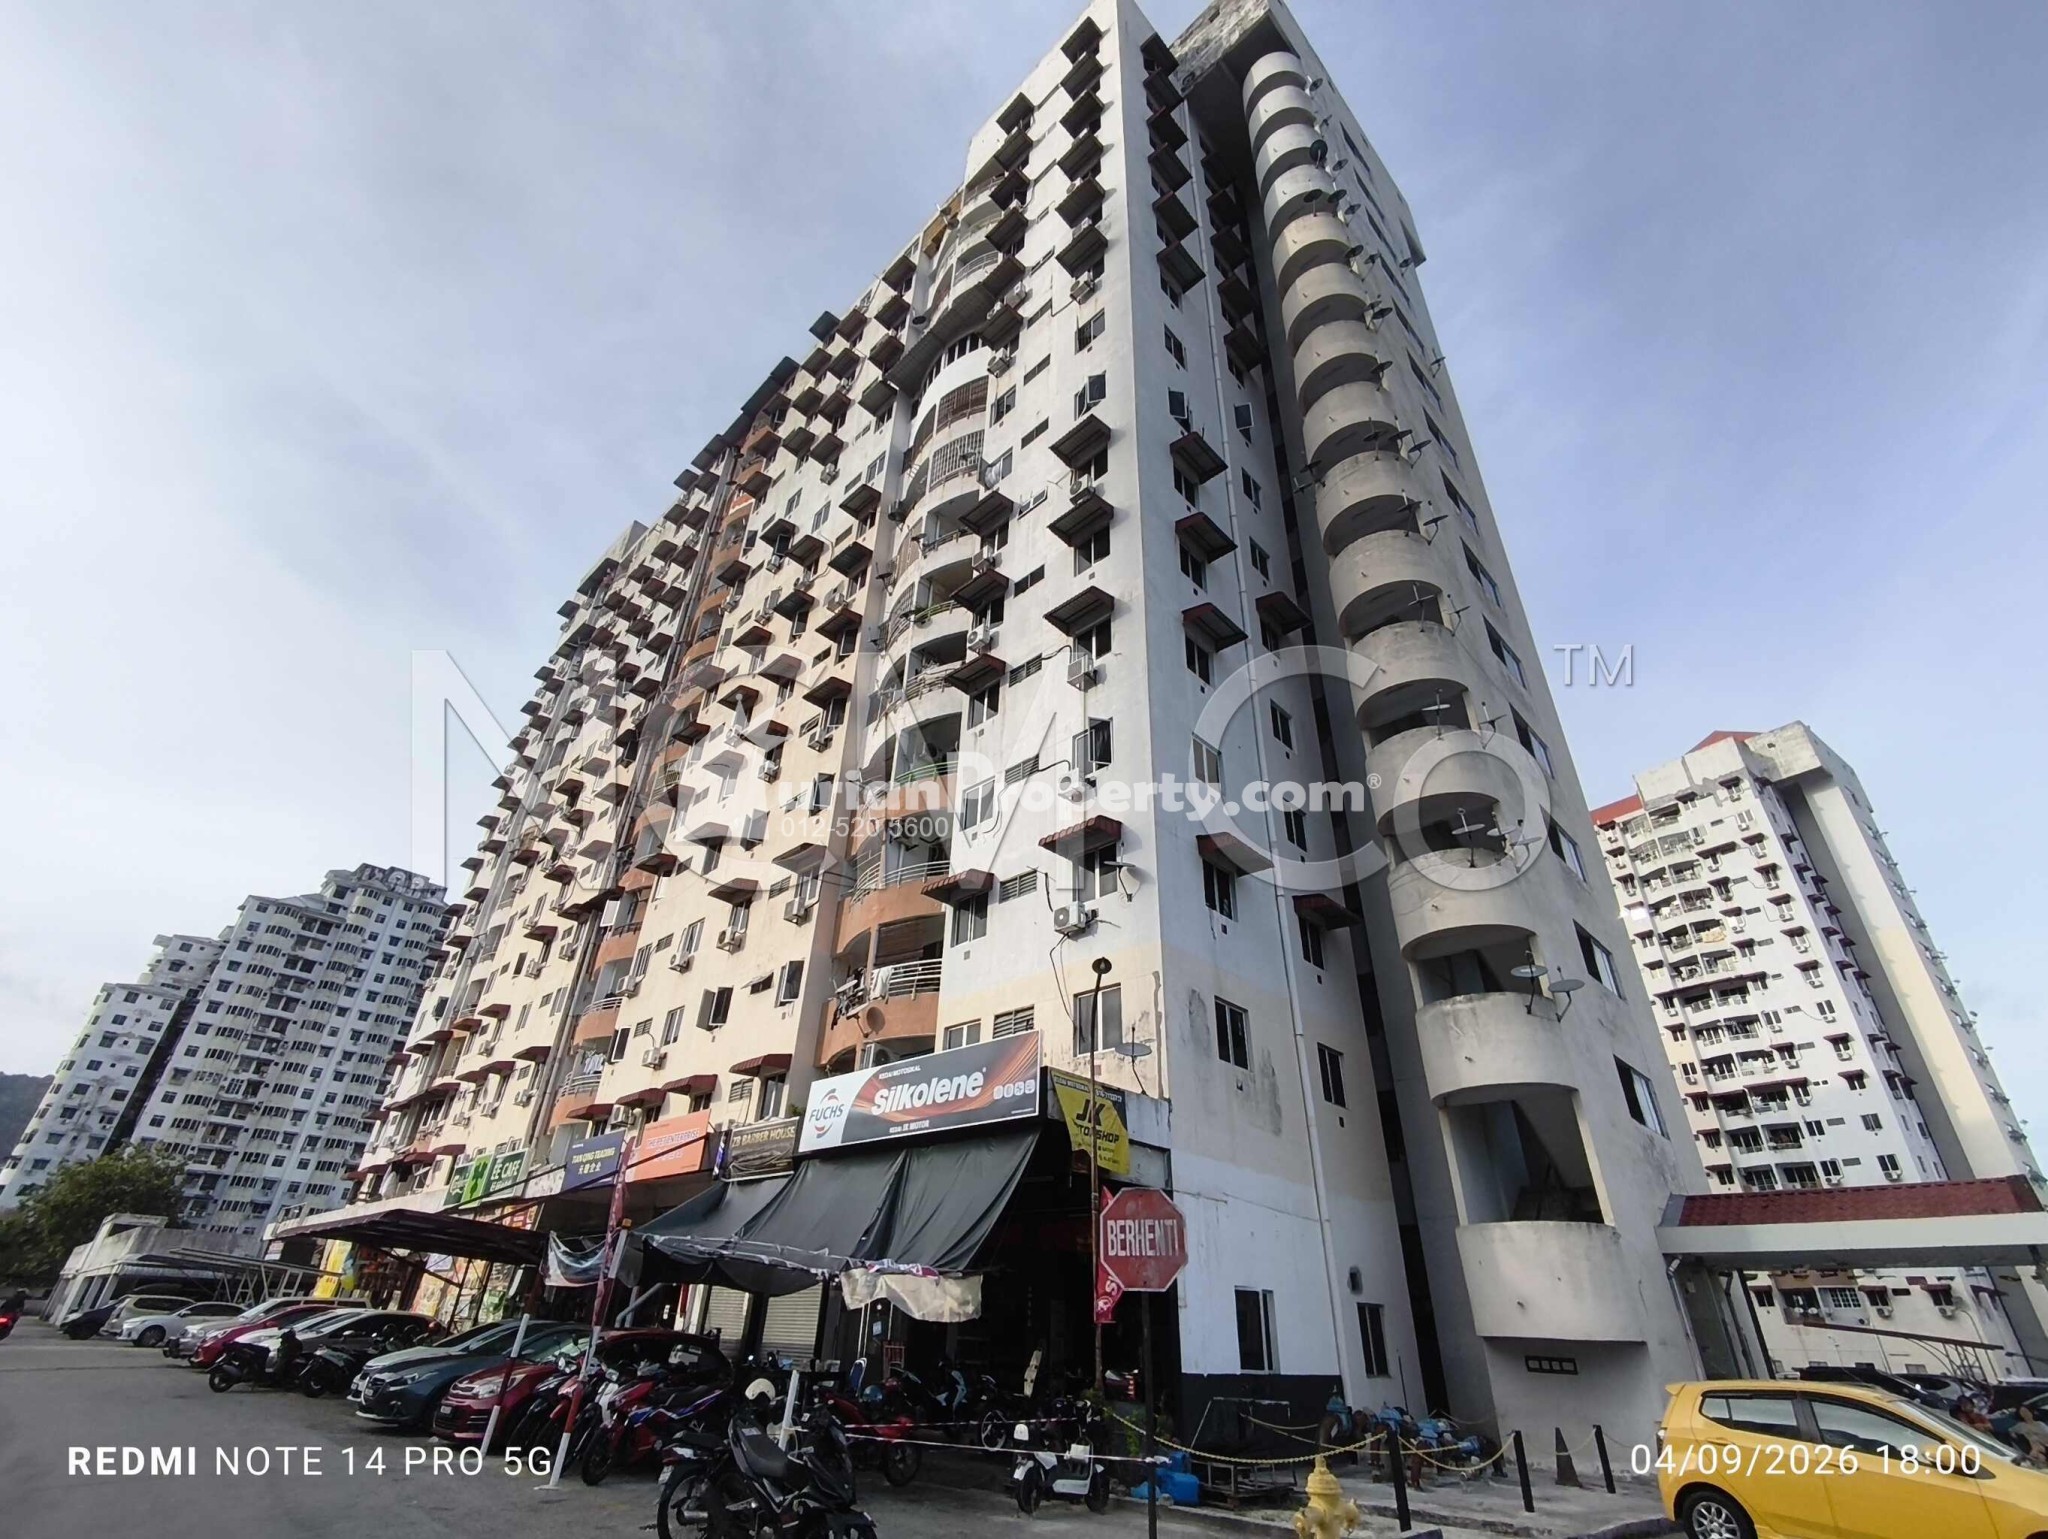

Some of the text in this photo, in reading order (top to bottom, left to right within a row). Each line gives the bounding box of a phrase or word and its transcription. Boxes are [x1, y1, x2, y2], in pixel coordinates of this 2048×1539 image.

[871, 1071, 986, 1116] Silkolene
[809, 1104, 843, 1122] FUCHS
[1076, 1099, 1105, 1126] JK
[1107, 1219, 1179, 1257] BERHENTI
